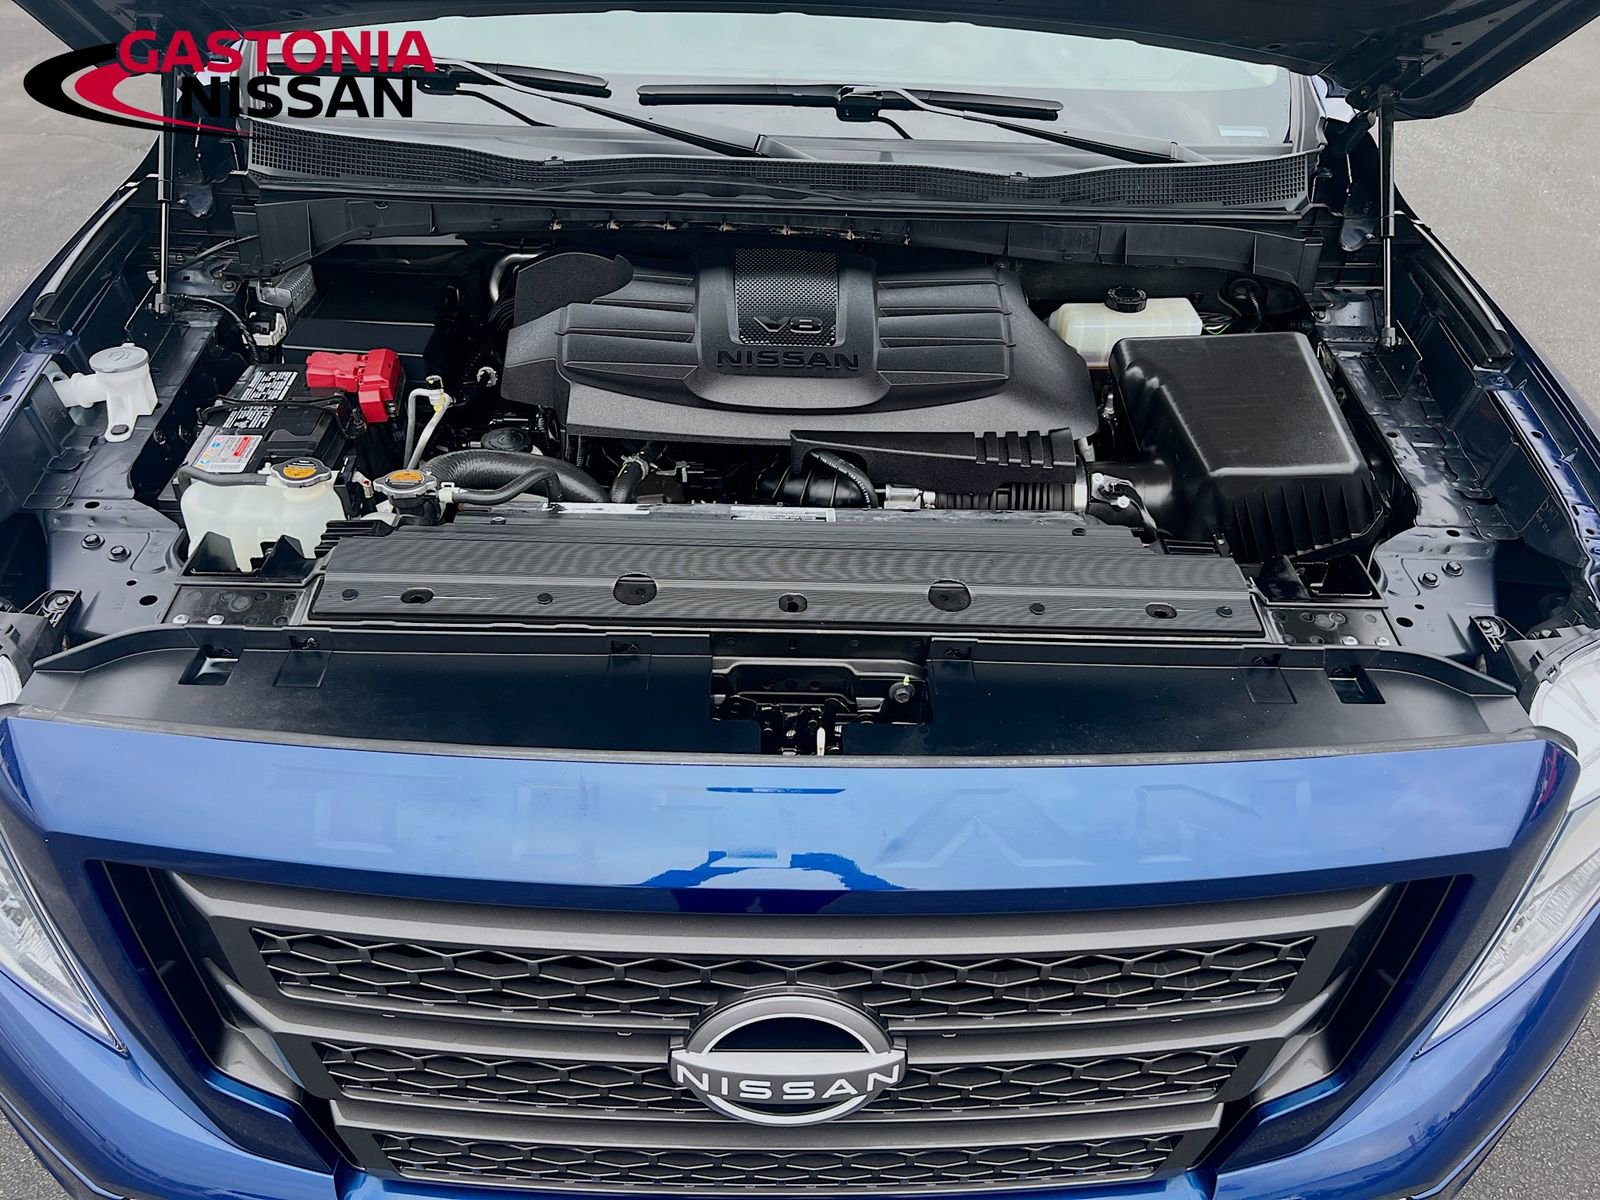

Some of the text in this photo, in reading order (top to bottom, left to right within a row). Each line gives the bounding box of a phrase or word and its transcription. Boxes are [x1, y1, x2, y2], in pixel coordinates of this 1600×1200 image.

[753, 316, 823, 334] V8
[716, 350, 860, 371] NISSAN
[676, 1064, 900, 1101] NISSAN
